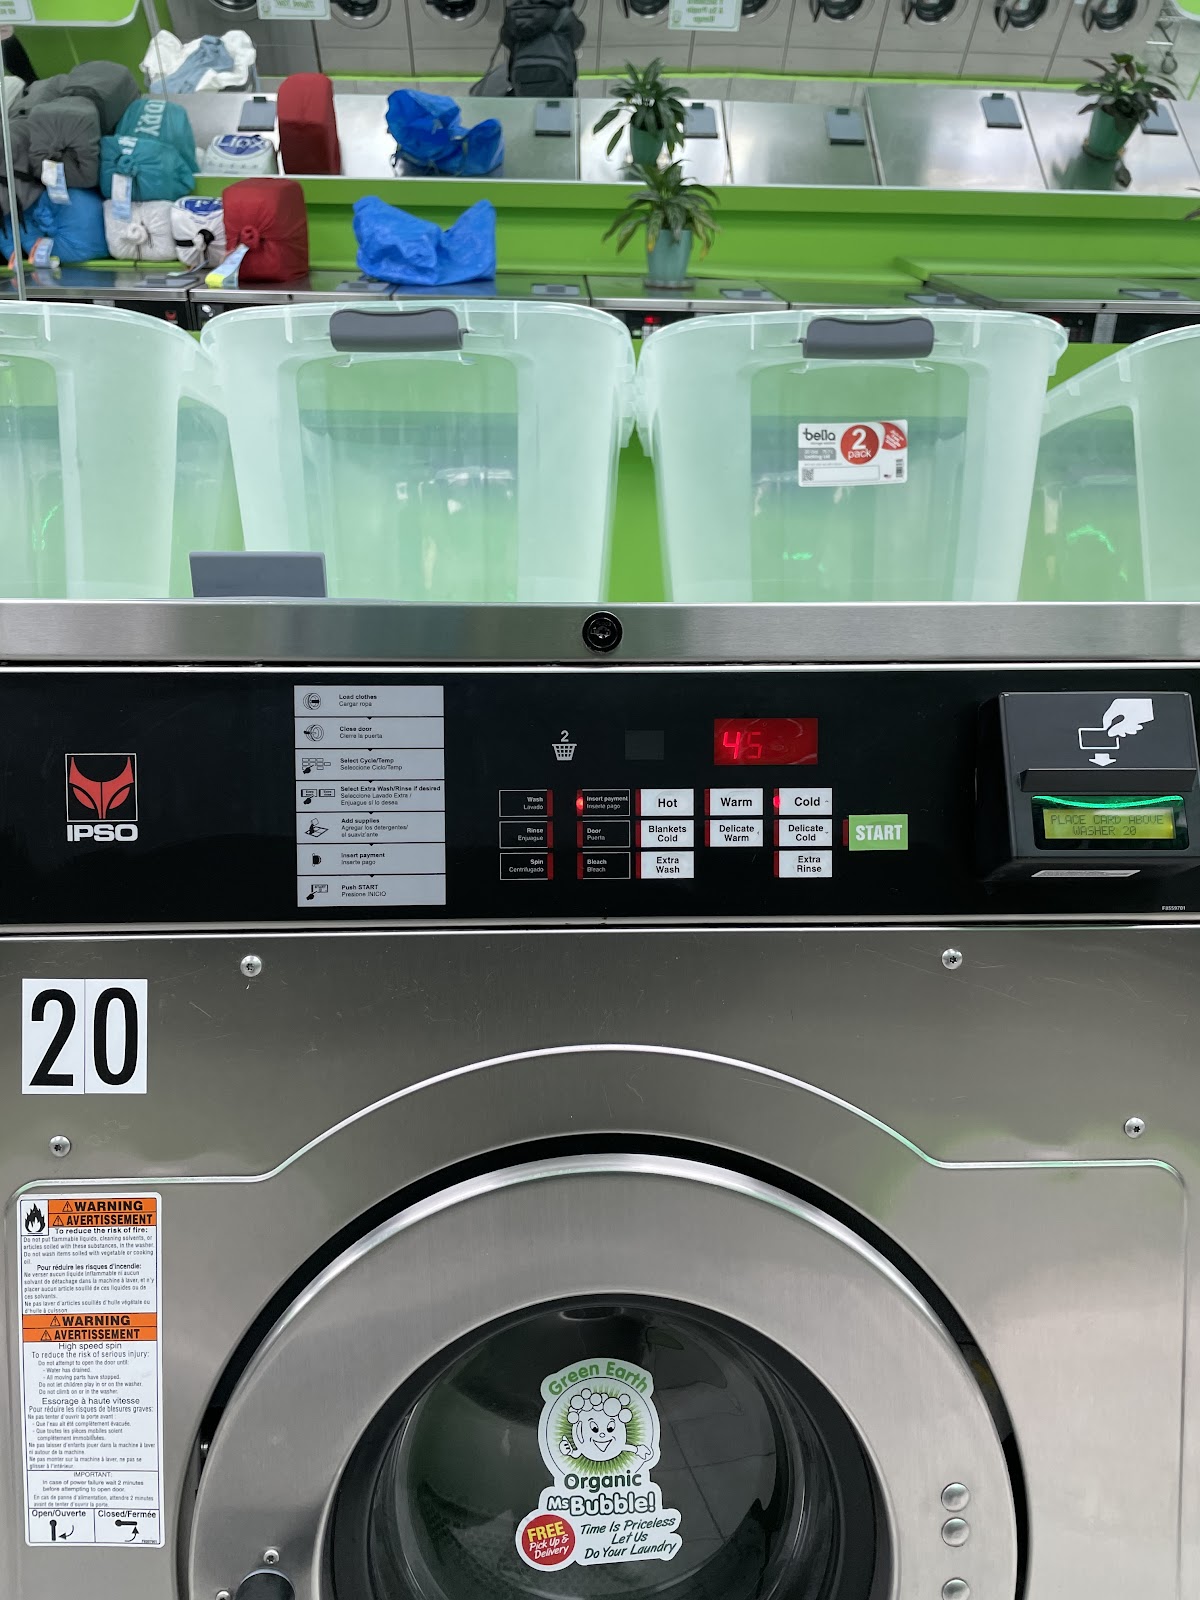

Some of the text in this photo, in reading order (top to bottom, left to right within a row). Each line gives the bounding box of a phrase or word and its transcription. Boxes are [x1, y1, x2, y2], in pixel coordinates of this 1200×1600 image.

[803, 428, 836, 441] bella
[852, 428, 866, 450] 2
[848, 449, 871, 460] pack
[560, 730, 569, 742] 2
[723, 732, 762, 759] 45
[658, 798, 678, 808] Hot
[720, 797, 753, 808] Warm
[794, 797, 820, 807] Cold
[1051, 815, 1163, 824] PLACE CARD ABOVE
[67, 824, 138, 841] IPSO
[648, 825, 687, 833] Blankets
[719, 824, 754, 834] Delicate
[788, 824, 824, 833] Delicate
[855, 824, 902, 841] START
[1073, 826, 1137, 835] WASHER 20
[657, 834, 678, 842] Cold
[724, 833, 750, 842] Warm
[795, 832, 816, 842] Cold
[656, 856, 680, 865] Extra
[798, 855, 821, 864] Extra
[655, 865, 680, 874] Wash
[797, 864, 822, 873] Rinse
[29, 988, 139, 1087] 20
[74, 1201, 143, 1211] WARNING
[67, 1214, 152, 1225] AVERTISSEMENT
[63, 1316, 130, 1326] WARNING
[54, 1329, 140, 1340] AVERTISSEMENT
[59, 1343, 78, 1351] High
[548, 1362, 648, 1396] Green Earth
[564, 1470, 642, 1493] Organic
[547, 1492, 656, 1517] Ms Bubble!
[527, 1521, 566, 1542] FREE
[581, 1517, 676, 1535] Time Is Priceless
[530, 1534, 569, 1551] Pick Up &
[612, 1531, 648, 1544] Let Us
[534, 1545, 569, 1559] Delivery
[585, 1542, 677, 1559] Do Your Laundry
